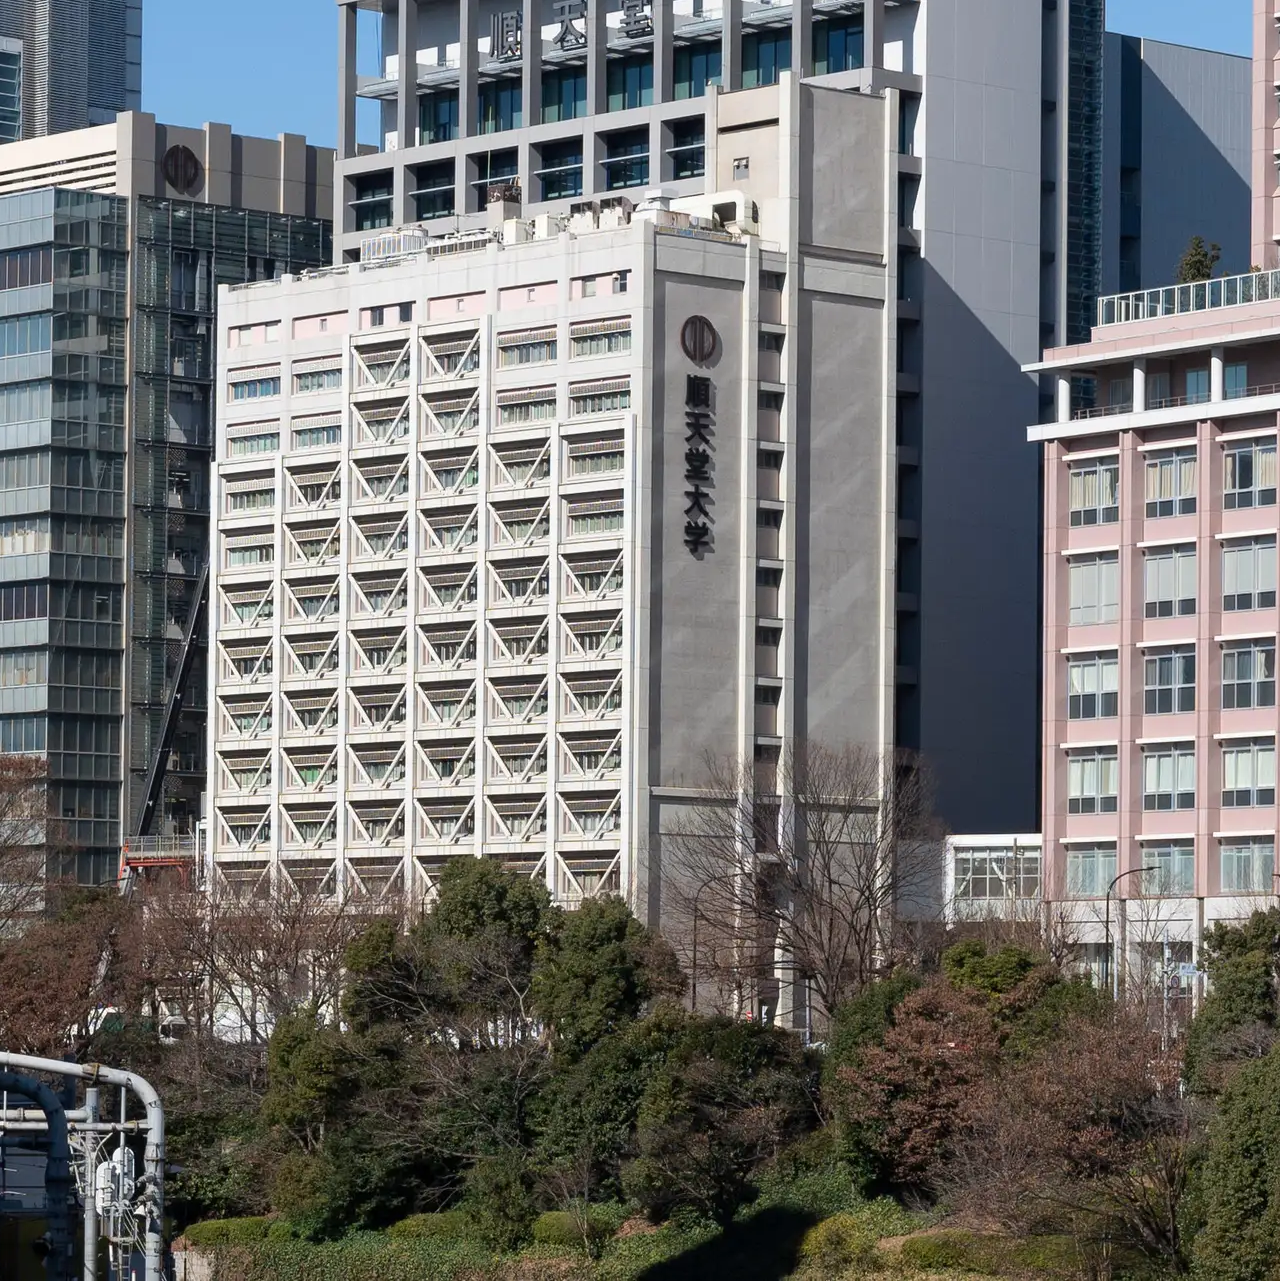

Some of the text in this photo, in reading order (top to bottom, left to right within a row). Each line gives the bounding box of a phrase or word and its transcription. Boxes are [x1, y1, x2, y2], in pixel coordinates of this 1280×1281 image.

[683, 374, 713, 553] 順天堂大学
